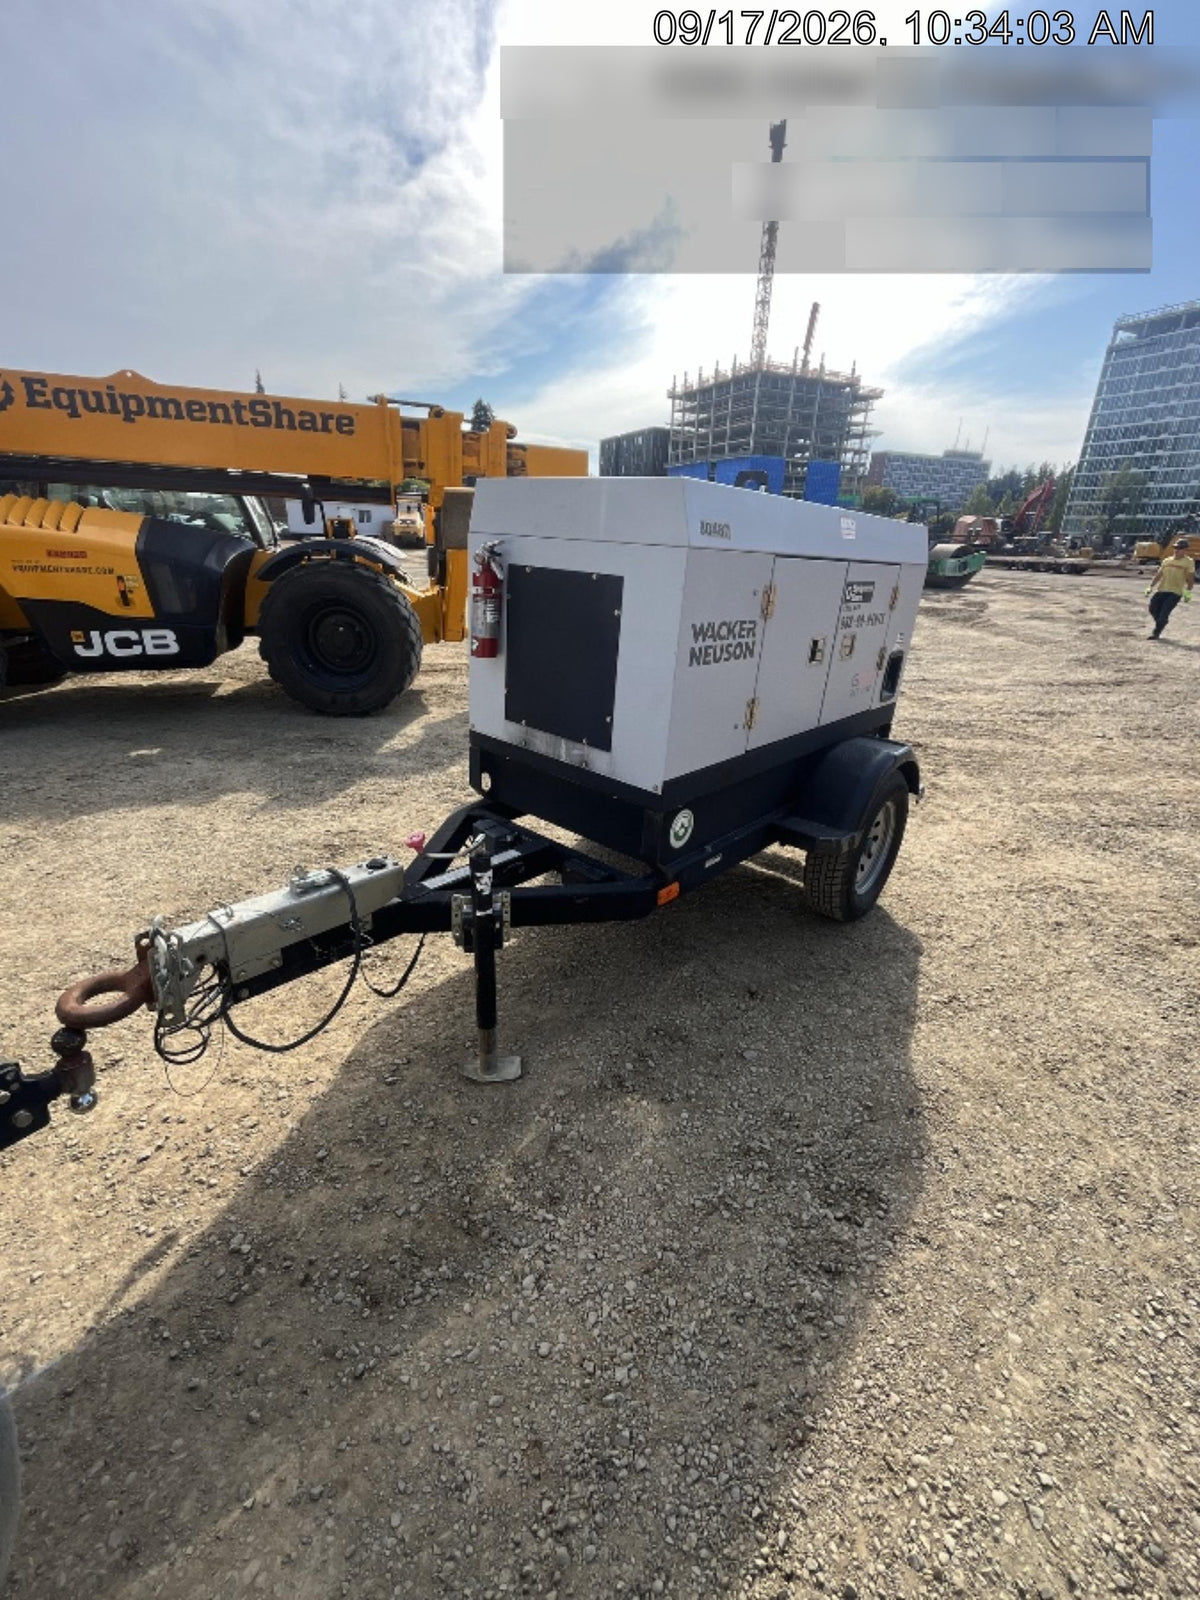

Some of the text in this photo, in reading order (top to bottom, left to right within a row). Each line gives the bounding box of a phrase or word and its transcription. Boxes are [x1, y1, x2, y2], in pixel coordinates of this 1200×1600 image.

[21, 375, 356, 436] EquipmentShare
[71, 628, 180, 657] JCB
[691, 619, 757, 644] WACKER
[688, 640, 757, 667] NEUSON
